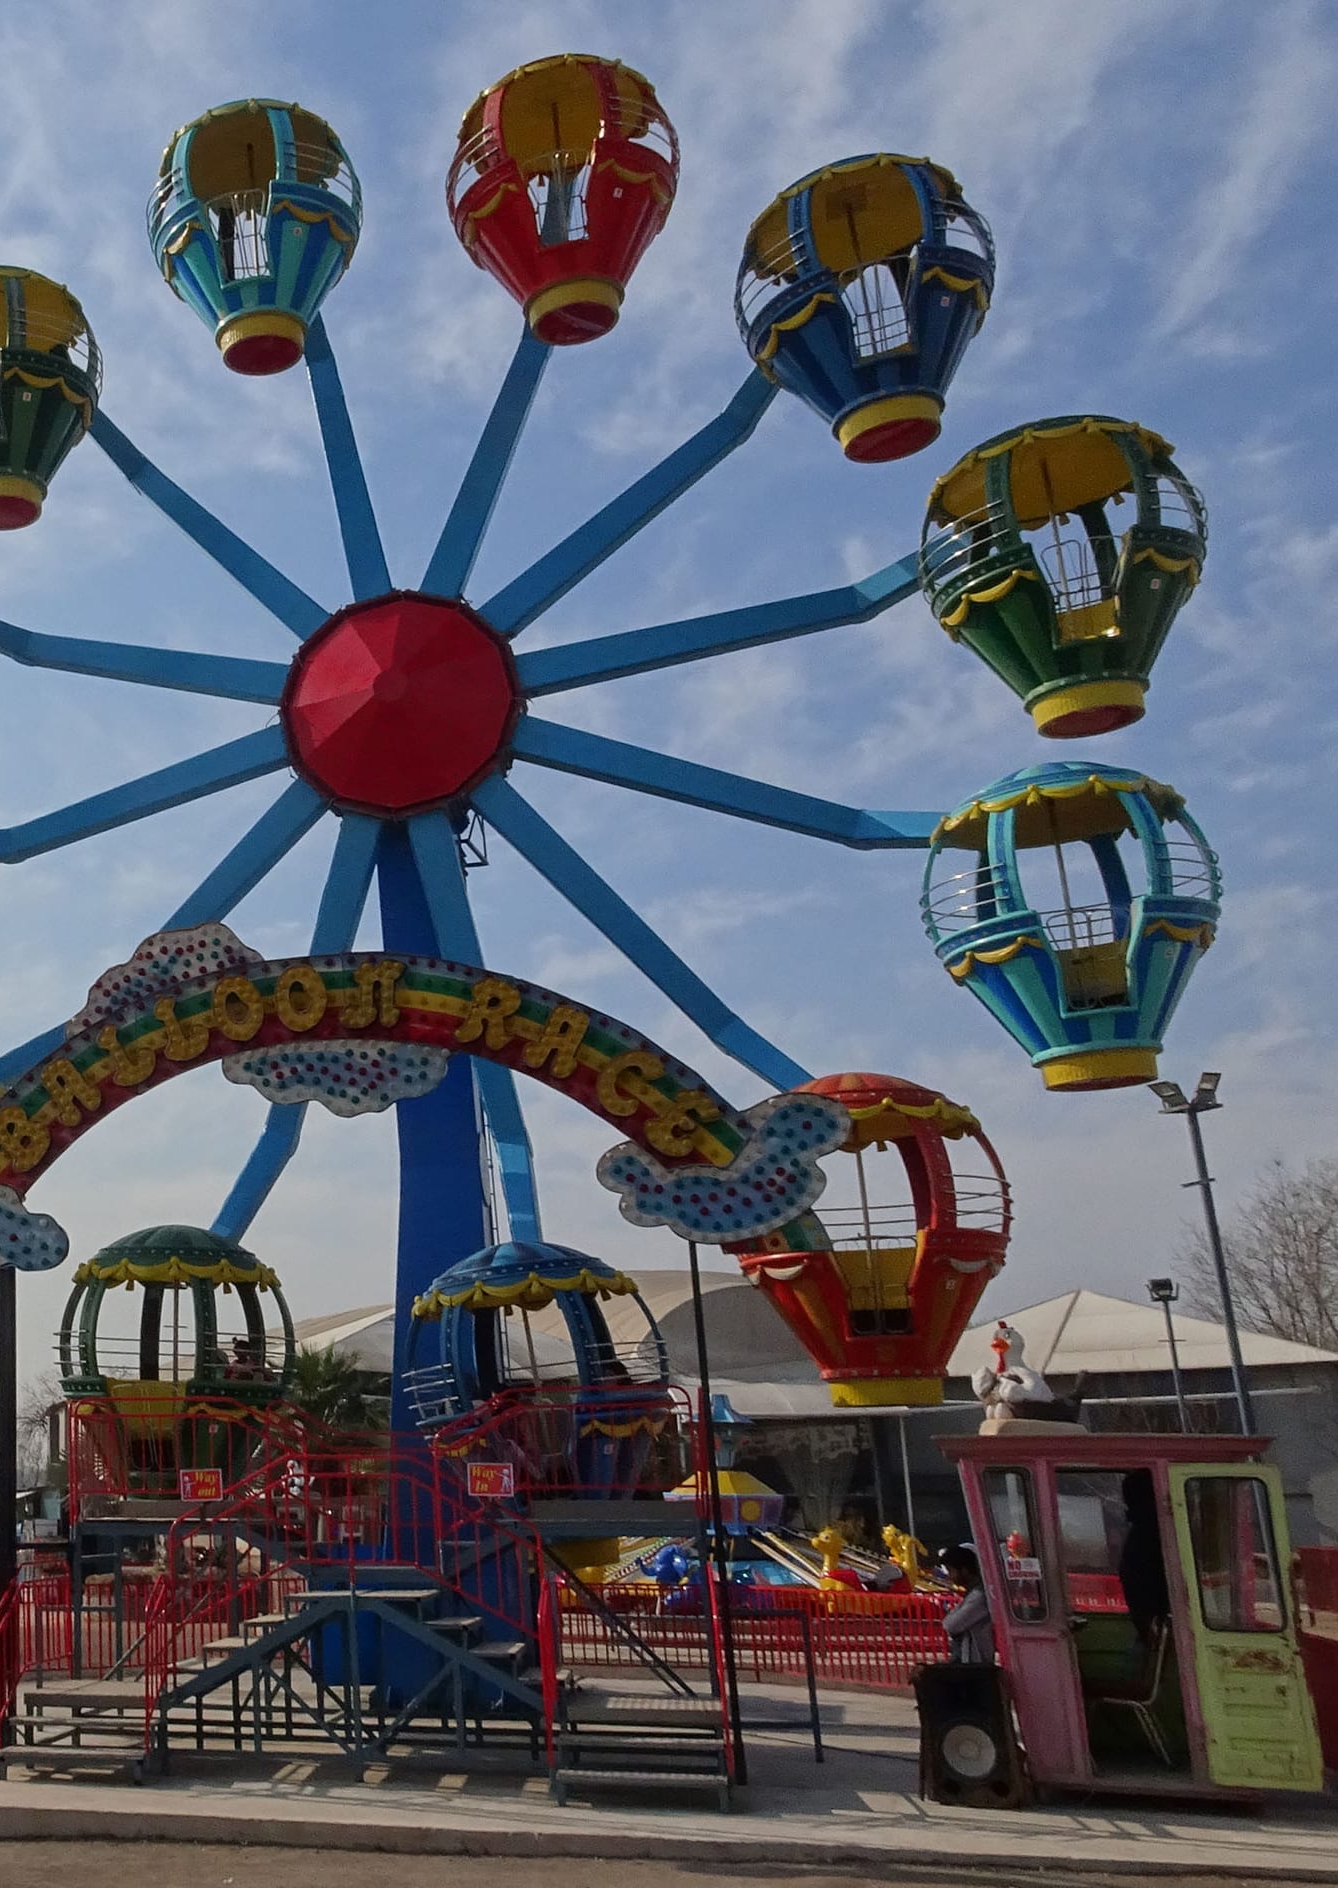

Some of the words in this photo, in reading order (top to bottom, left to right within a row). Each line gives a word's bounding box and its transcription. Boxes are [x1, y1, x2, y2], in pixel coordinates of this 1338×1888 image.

[454, 976, 721, 1157] RACE
[194, 1471, 217, 1485] Way
[472, 1465, 495, 1480] Way
